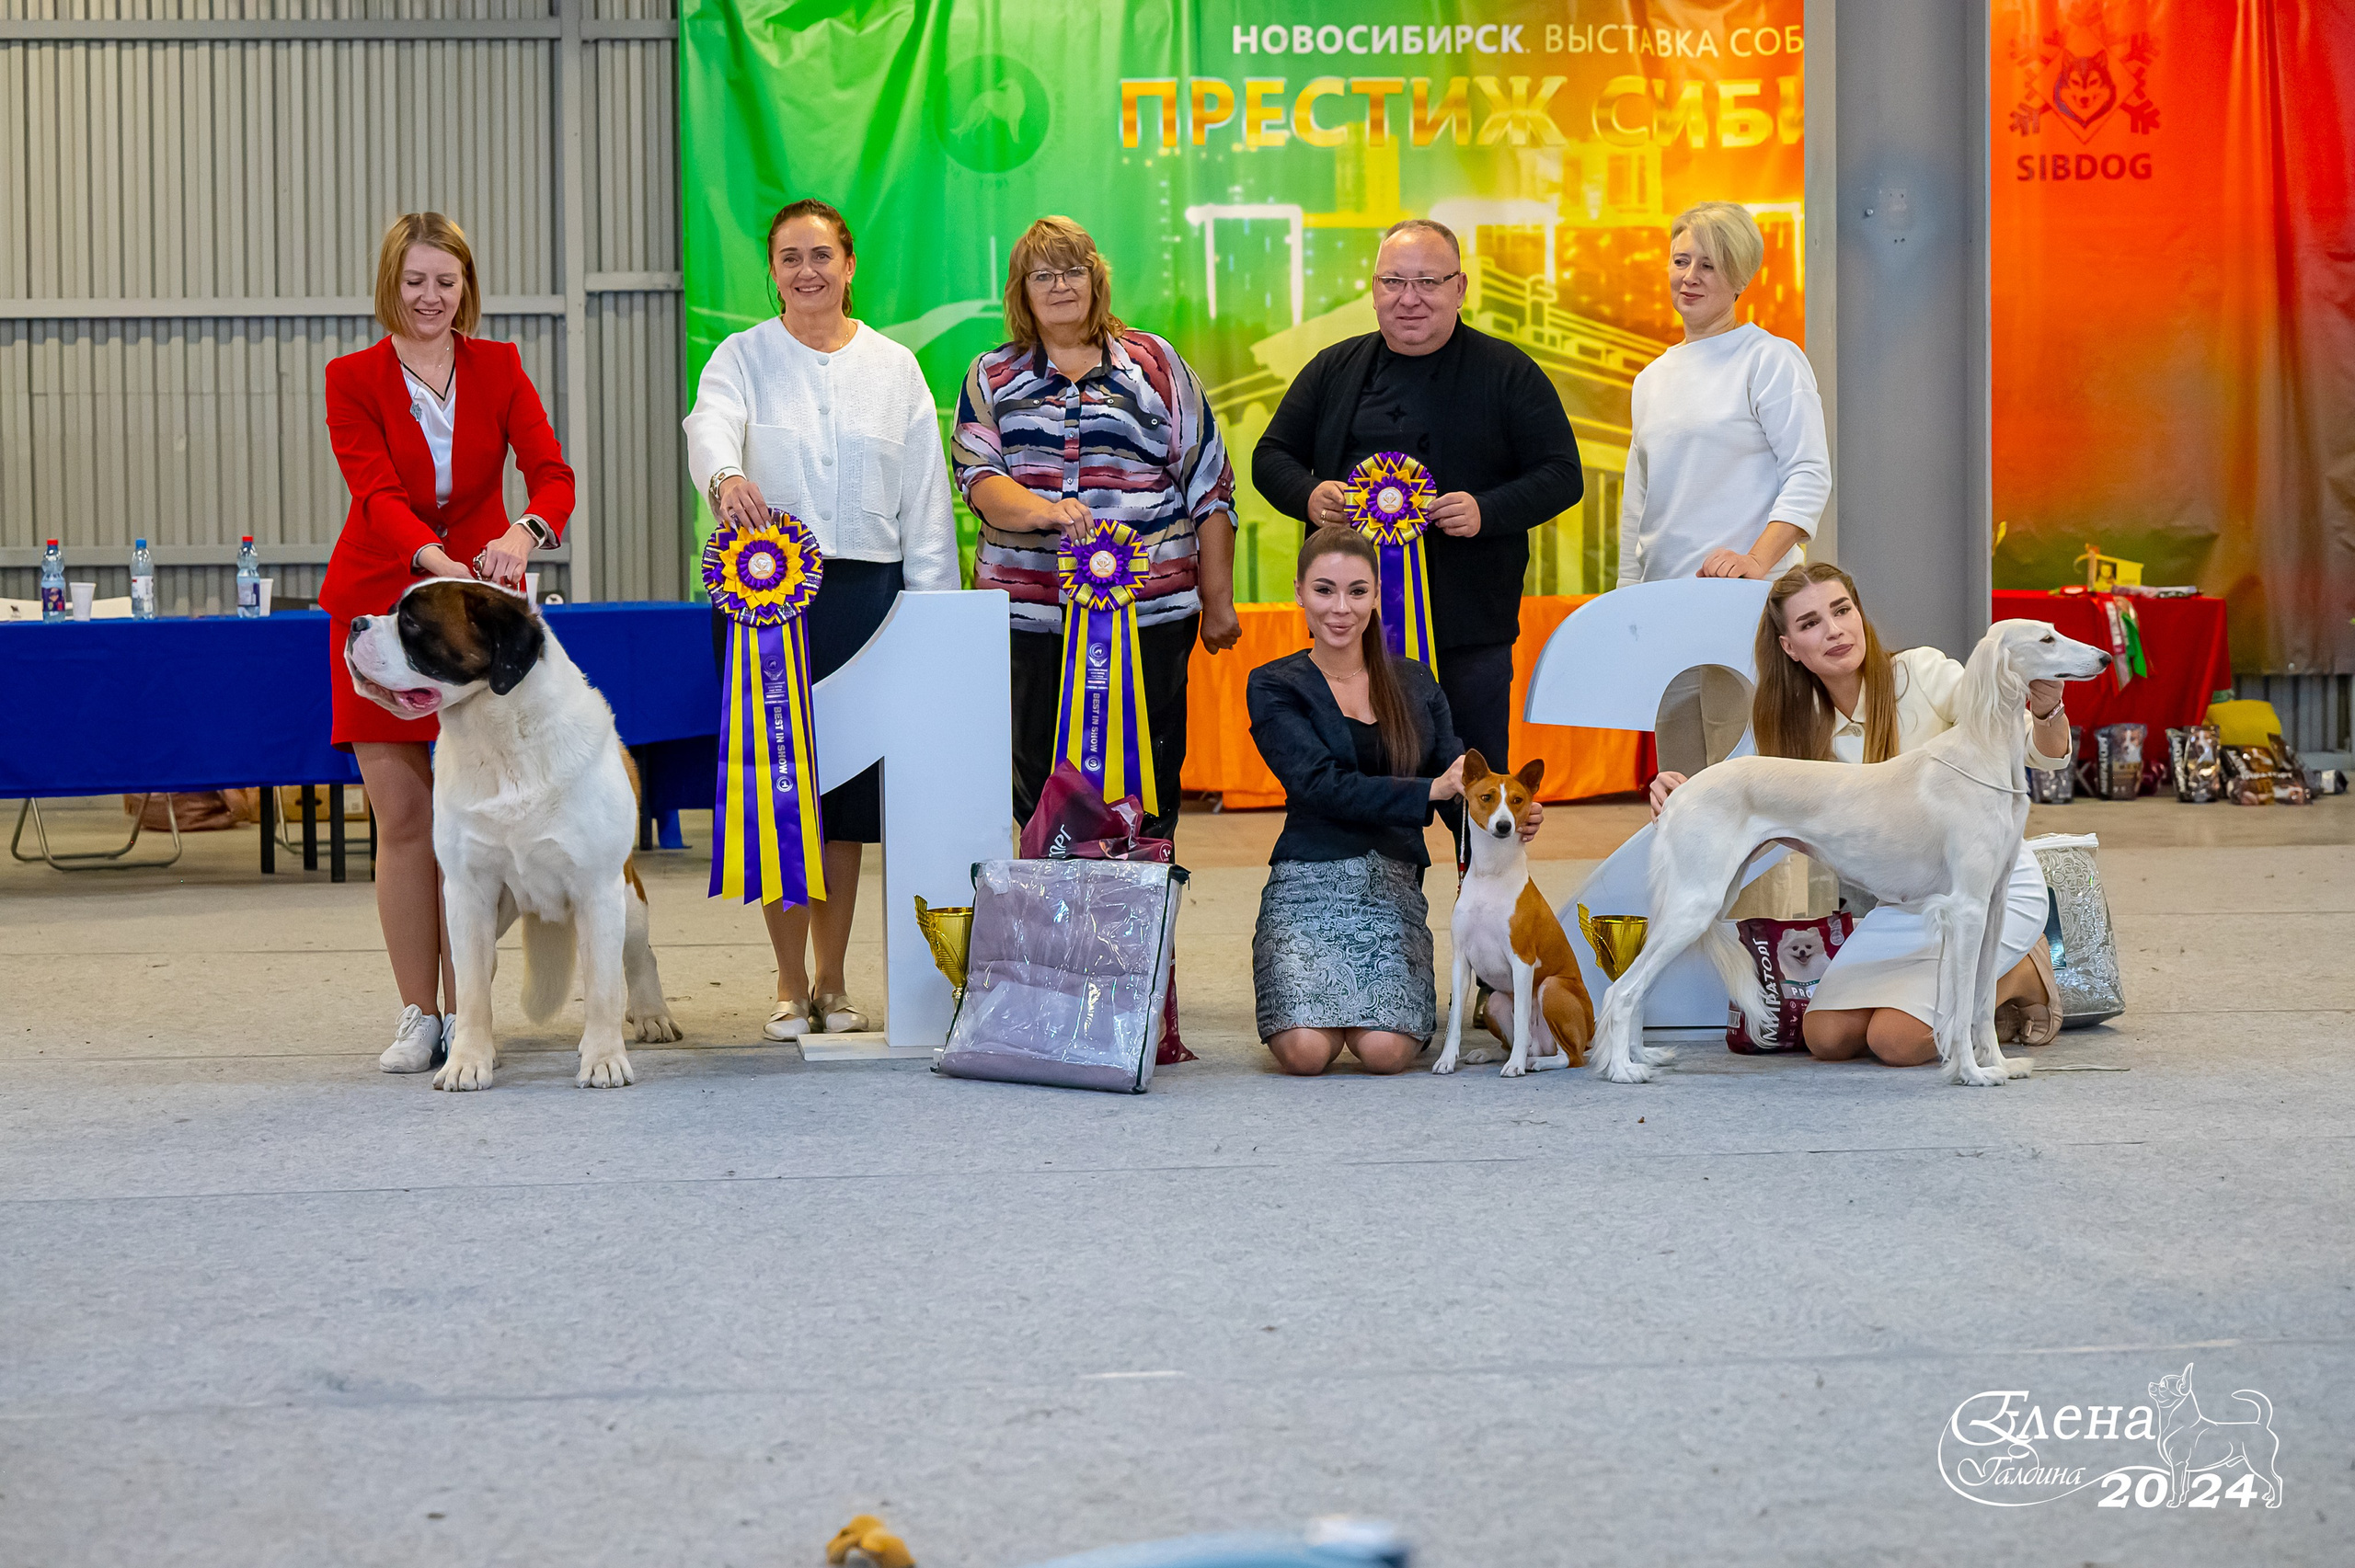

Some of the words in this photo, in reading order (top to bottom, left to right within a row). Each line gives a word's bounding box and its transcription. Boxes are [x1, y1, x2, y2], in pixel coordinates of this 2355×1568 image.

[1545, 23, 1719, 59] ВЫСТАВКА
[1729, 25, 1804, 58] СОБ
[1119, 75, 1568, 150] ПРЕСТИЖ
[2016, 153, 2153, 182] SIBDOG
[1092, 692, 1100, 714] BEST
[774, 706, 784, 730] BEST
[1091, 715, 1099, 725] IN
[775, 733, 785, 743] IN
[1090, 727, 1098, 752] SHOW
[777, 745, 788, 774] SHOW
